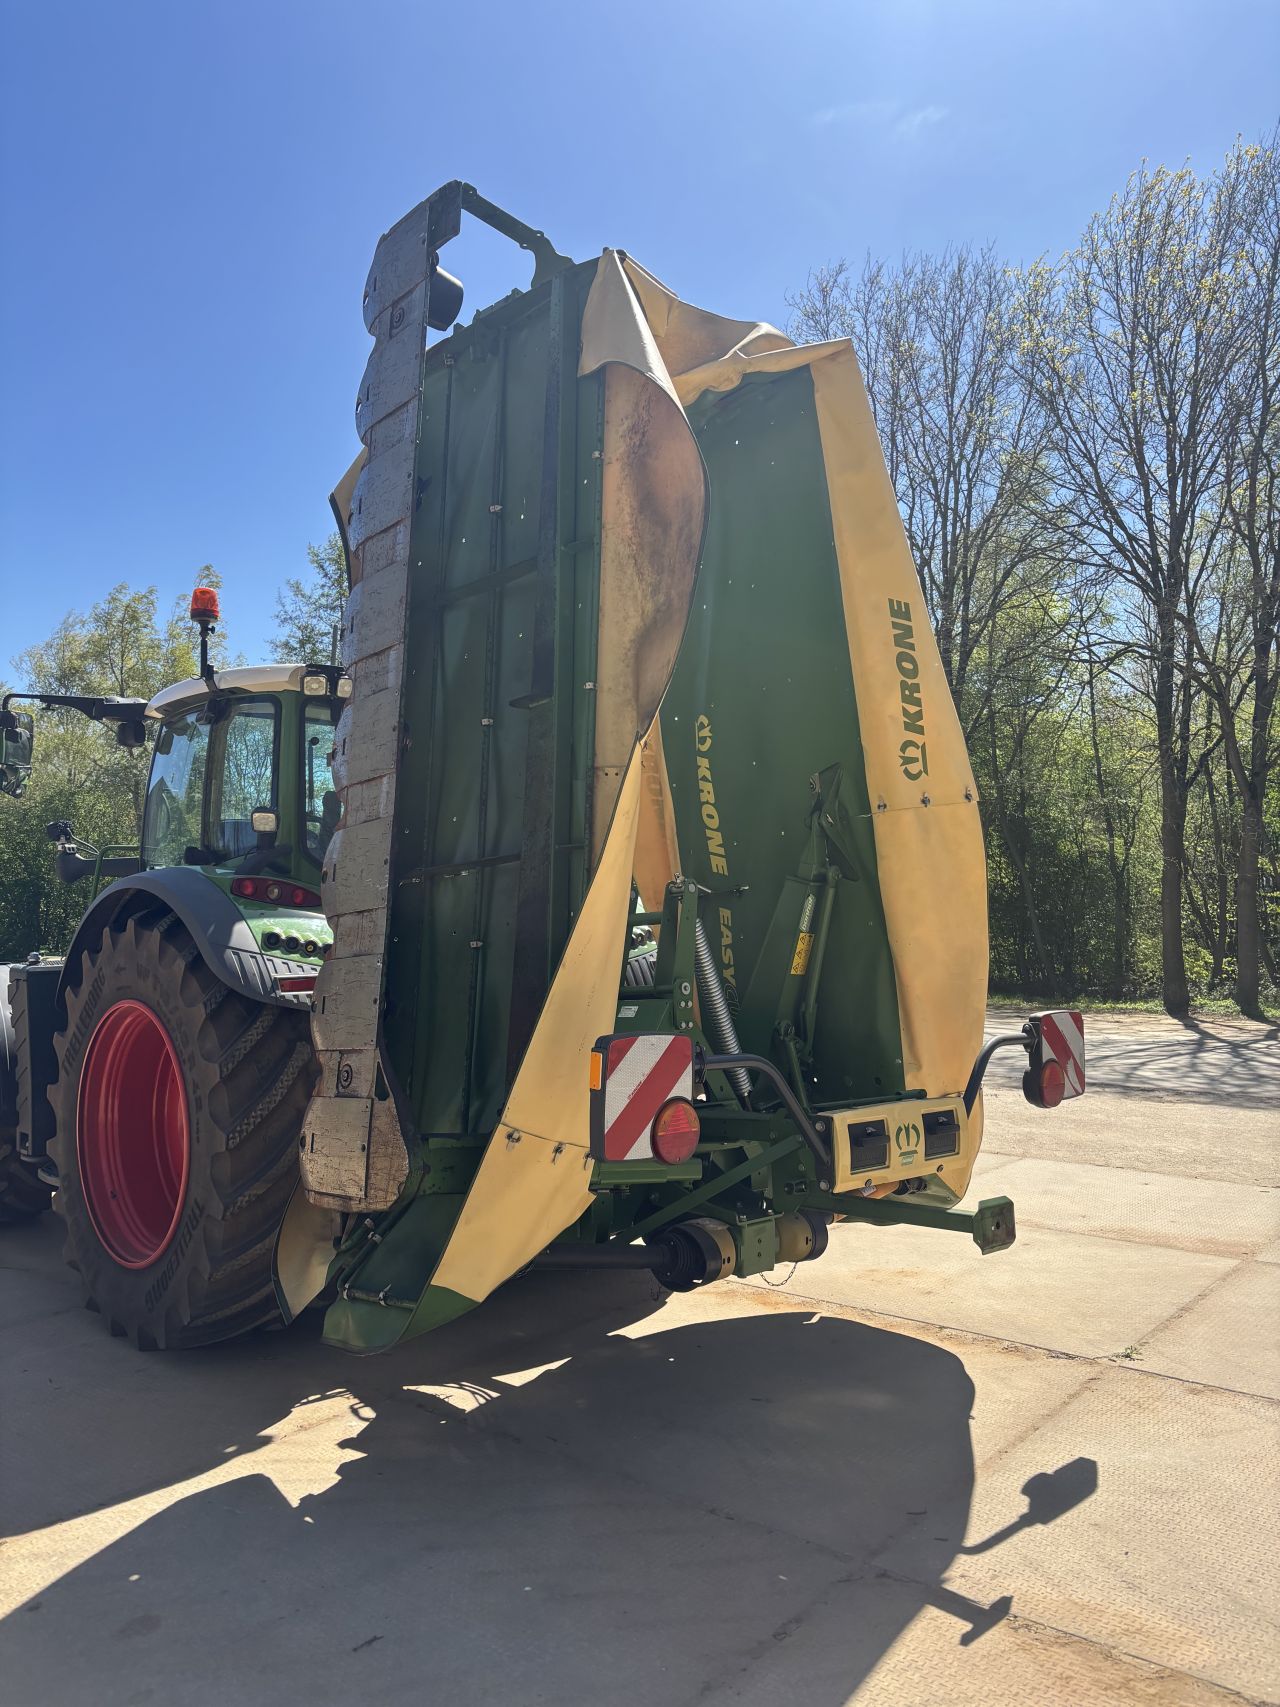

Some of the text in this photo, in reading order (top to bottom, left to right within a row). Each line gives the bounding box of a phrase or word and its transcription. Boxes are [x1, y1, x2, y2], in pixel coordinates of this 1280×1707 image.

[888, 598, 925, 736] KRONE
[696, 756, 728, 877] KRONE
[62, 966, 106, 1076] TRELLEBORG
[144, 1197, 206, 1312] TRELLEBORG
